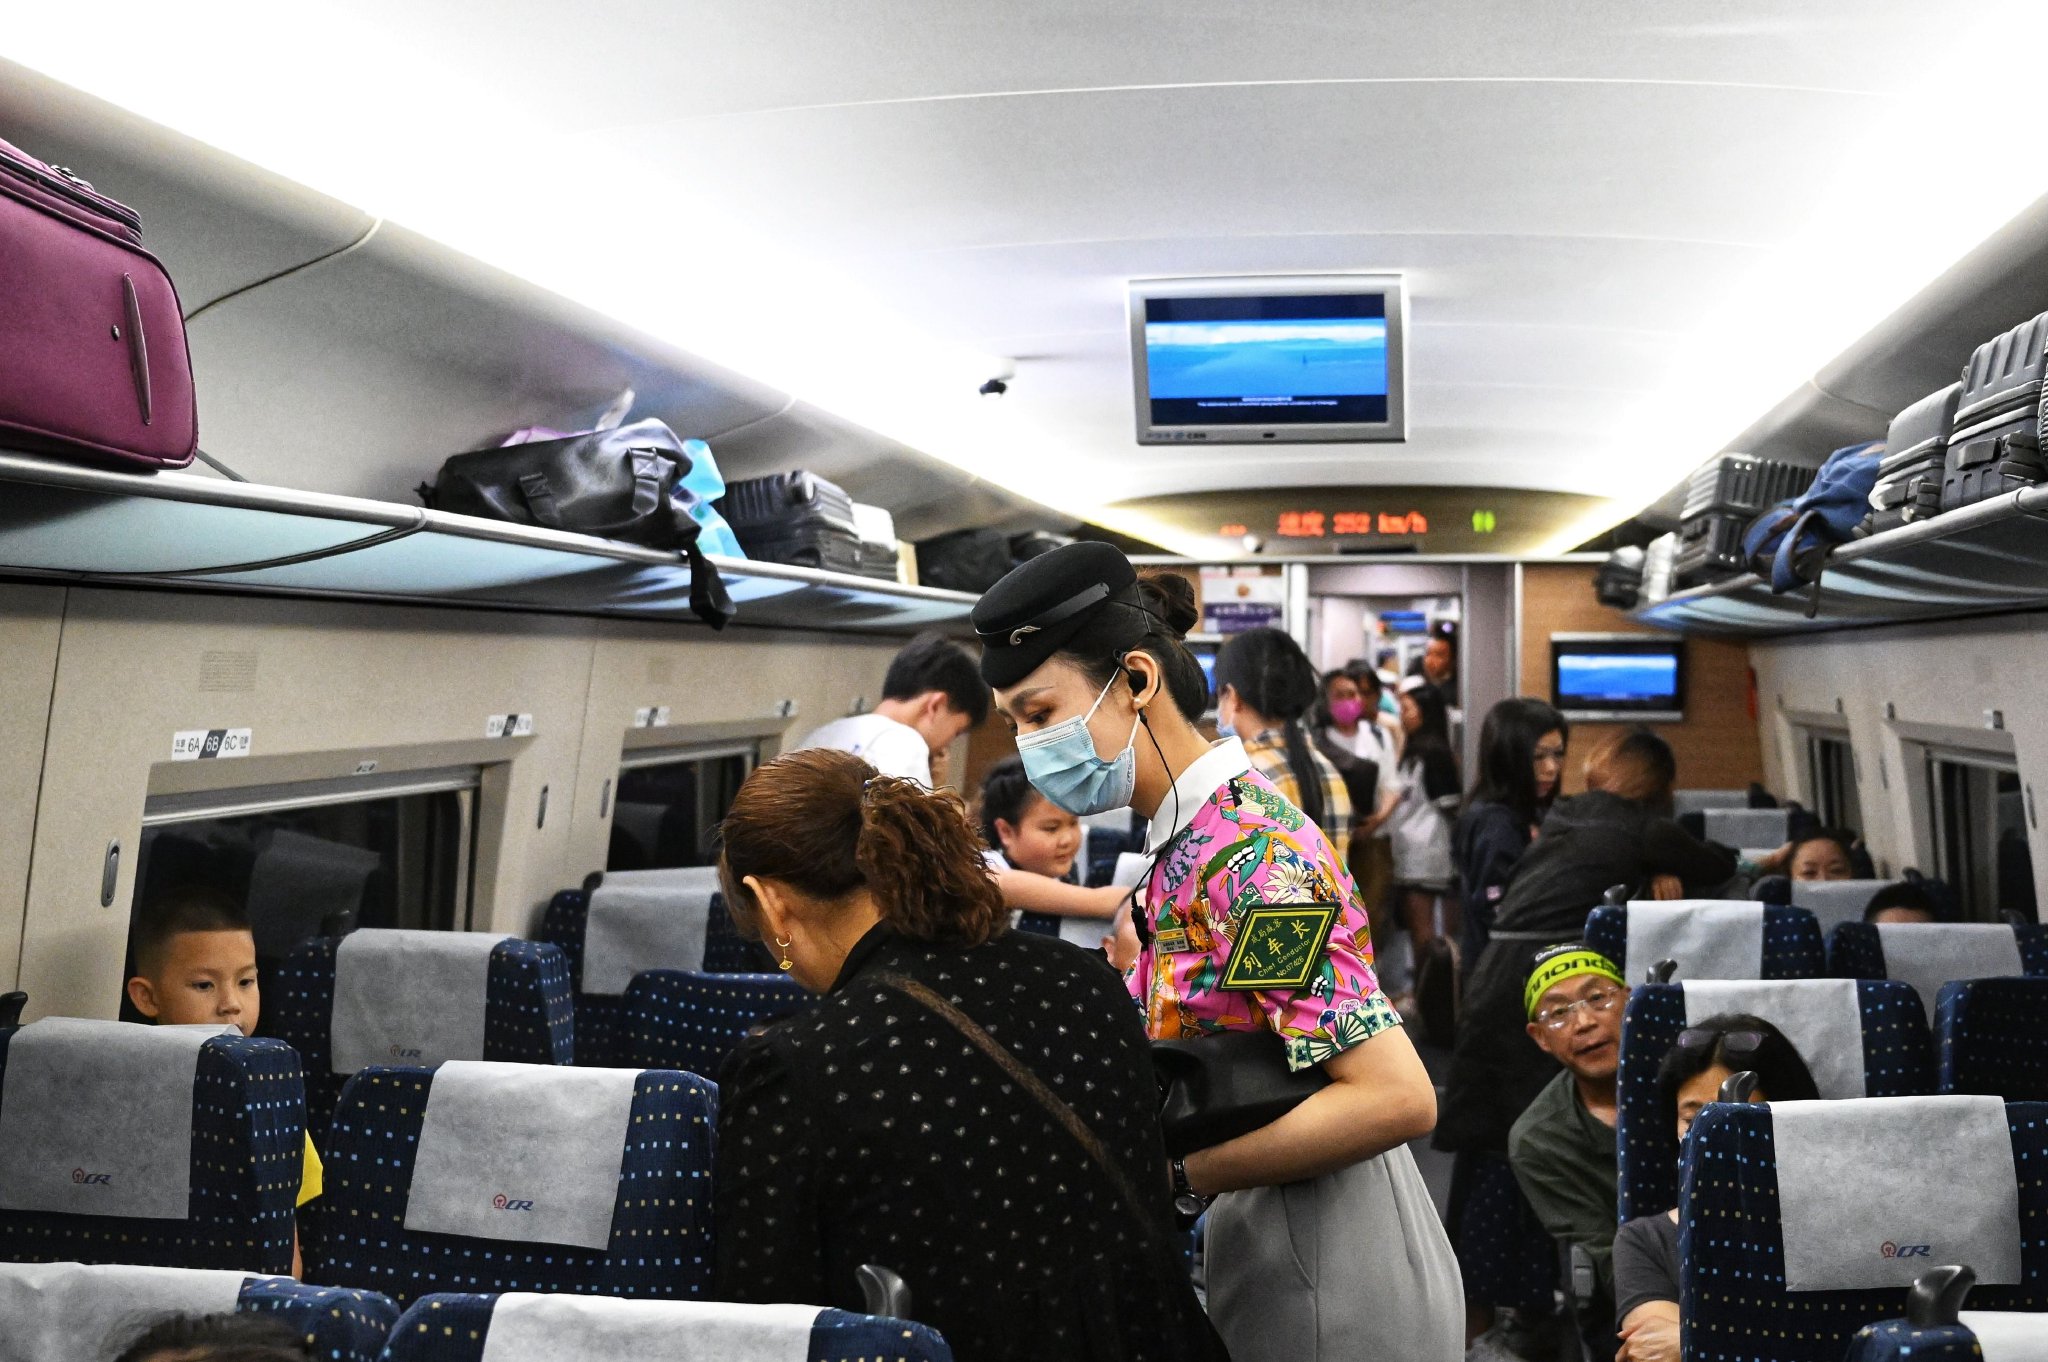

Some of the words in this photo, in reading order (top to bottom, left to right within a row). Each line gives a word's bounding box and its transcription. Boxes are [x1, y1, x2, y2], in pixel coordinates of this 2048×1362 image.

[188, 737, 200, 752] 6A
[206, 736, 219, 752] 6B
[224, 735, 238, 751] 6C
[1257, 962, 1276, 977] Chief
[1277, 938, 1311, 964] Conductor
[505, 1199, 534, 1211] CR
[1896, 1245, 1931, 1258] CR
